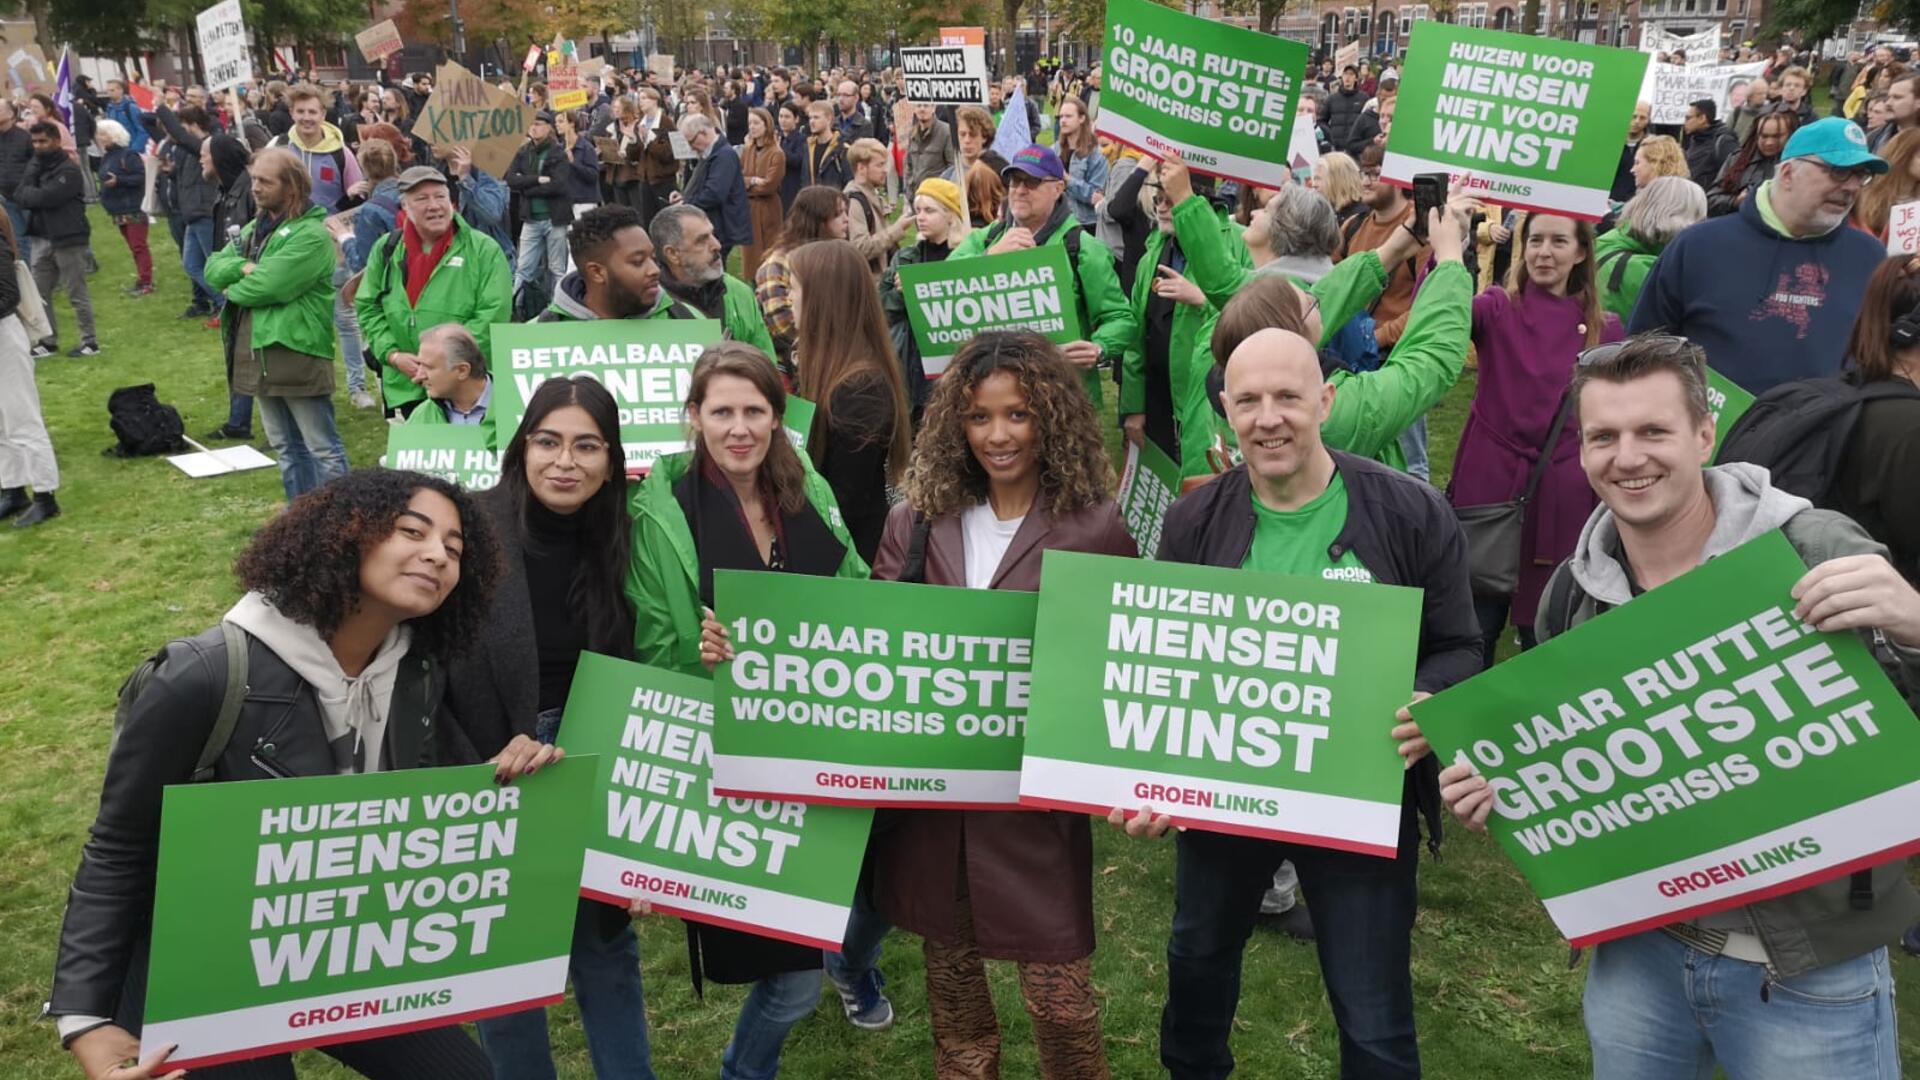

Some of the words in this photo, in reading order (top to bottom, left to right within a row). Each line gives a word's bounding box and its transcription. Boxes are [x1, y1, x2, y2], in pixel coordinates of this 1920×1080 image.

[903, 54, 933, 72] WHO
[935, 53, 963, 72] PAYS
[1112, 24, 1135, 44] 10
[1140, 28, 1196, 68] JAAR
[1203, 53, 1291, 91] RUTTE:
[1449, 42, 1526, 67] HUIZEN
[1532, 53, 1594, 78] VOOR
[440, 78, 490, 107] HAHA
[906, 80, 930, 98] FOR
[931, 80, 979, 99] PROFIT?
[1109, 47, 1288, 121] GROOTSTE
[1441, 63, 1589, 109] MENSEN
[1109, 73, 1223, 128] WOONCRISIS
[1228, 115, 1282, 141] OOIT
[1435, 94, 1495, 121] NIET
[1502, 105, 1579, 136] VOOR
[1432, 118, 1573, 171] WINST
[1897, 207, 1914, 226] JE
[1897, 227, 1920, 238] WO
[914, 266, 1056, 299] BETAALBAAR
[920, 286, 1062, 328] WONEN
[511, 343, 704, 369] BETAALBAAR
[927, 328, 973, 344] VOOR
[396, 449, 456, 470] MIJN
[1111, 582, 1234, 618] HUIZEN
[1245, 596, 1340, 630] VOOR
[732, 616, 776, 644] 10
[788, 622, 888, 656] JAAR
[1108, 613, 1338, 676] MENSEN
[731, 650, 1031, 708] GROOTSTE
[1104, 661, 1200, 699] NIET
[1212, 674, 1331, 717] VOOR
[631, 687, 714, 725] HUIZE
[731, 696, 945, 735] WOONCRISIS
[1102, 698, 1329, 773] WINST
[1453, 739, 1505, 776] 10
[1513, 688, 1625, 755] JAAR
[1490, 641, 1860, 822] GROOTSTE
[611, 756, 696, 800] NIET
[816, 772, 946, 792] GROENLINKS
[1134, 782, 1279, 816] GROENLINKS
[1513, 754, 1760, 856] WOONCRISIS
[1765, 700, 1880, 770] OOIT
[259, 797, 410, 836] HUIZEN
[423, 787, 520, 820] VOOR
[607, 790, 800, 876] WINST
[254, 818, 517, 886] MENSEN
[1658, 837, 1821, 898] GROENLINKS
[250, 886, 369, 931] NIET
[384, 868, 511, 911] VOOR
[620, 870, 748, 910] GROENLINKS
[249, 904, 506, 988] WINST
[288, 988, 452, 1029] GROENLINKS
